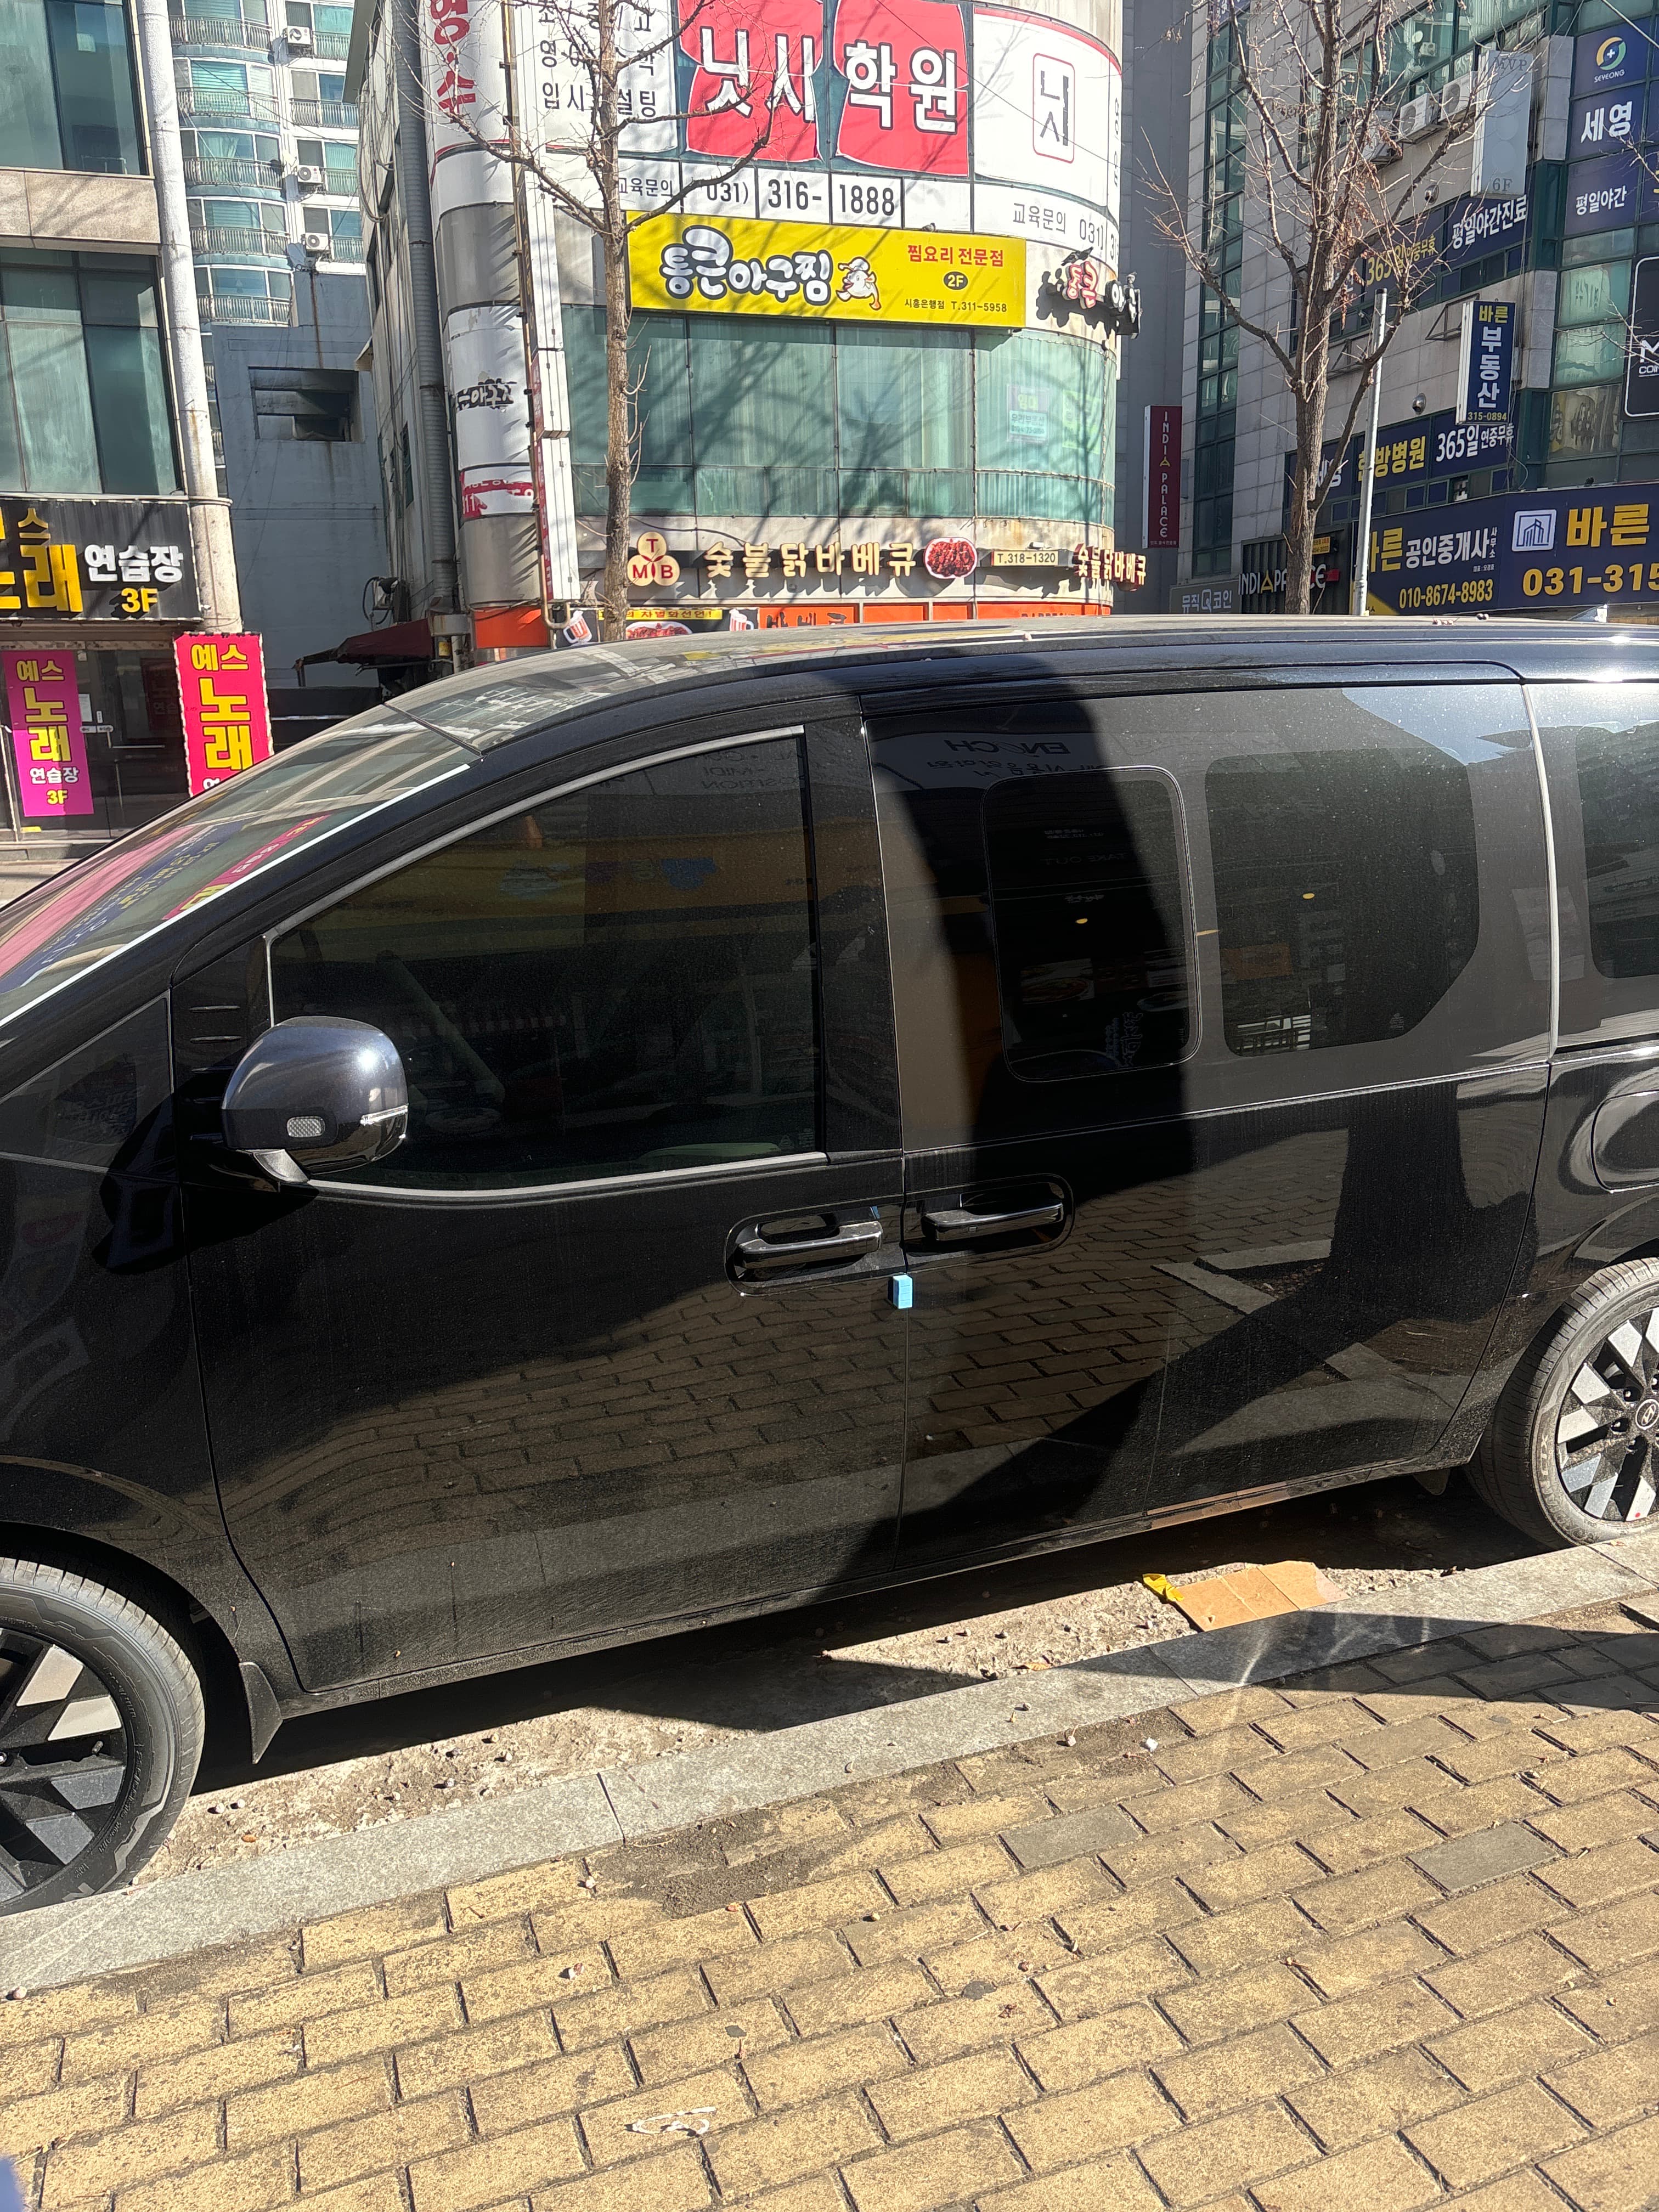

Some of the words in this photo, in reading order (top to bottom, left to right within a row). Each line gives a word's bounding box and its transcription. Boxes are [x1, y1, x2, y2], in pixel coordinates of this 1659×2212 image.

[1594, 69, 1626, 83] SEYEONG
[1581, 101, 1633, 143] 세영
[1492, 177, 1513, 192] 6F
[1576, 185, 1628, 216] 평일야간
[1013, 202, 1066, 234] 교육문의
[660, 225, 833, 306] 통큰아구찜
[908, 244, 953, 264] 찜요리
[958, 248, 1003, 267] 전문점
[947, 274, 964, 287] 2F
[904, 298, 945, 309] 시흥은행점
[951, 301, 1007, 313] T.311-5958
[1479, 305, 1508, 324] 바른
[1477, 326, 1502, 409] 부동산
[1468, 411, 1508, 421] 315-0894
[1159, 411, 1171, 467] INDIA
[1435, 425, 1480, 462] 365일
[1159, 472, 1169, 538] PALACE
[1566, 504, 1650, 548] 바른
[1406, 528, 1489, 569] 공인중개사
[1488, 526, 1498, 558] 사무소
[84, 544, 184, 583] 연습장
[997, 552, 1056, 564] T.318-1320
[121, 588, 159, 613] 3F
[1400, 579, 1494, 609] 010-8674-8983
[16, 660, 66, 681] 예스
[191, 644, 249, 672] 예스
[30, 767, 80, 785] 연습장
[46, 790, 68, 805] 3F
